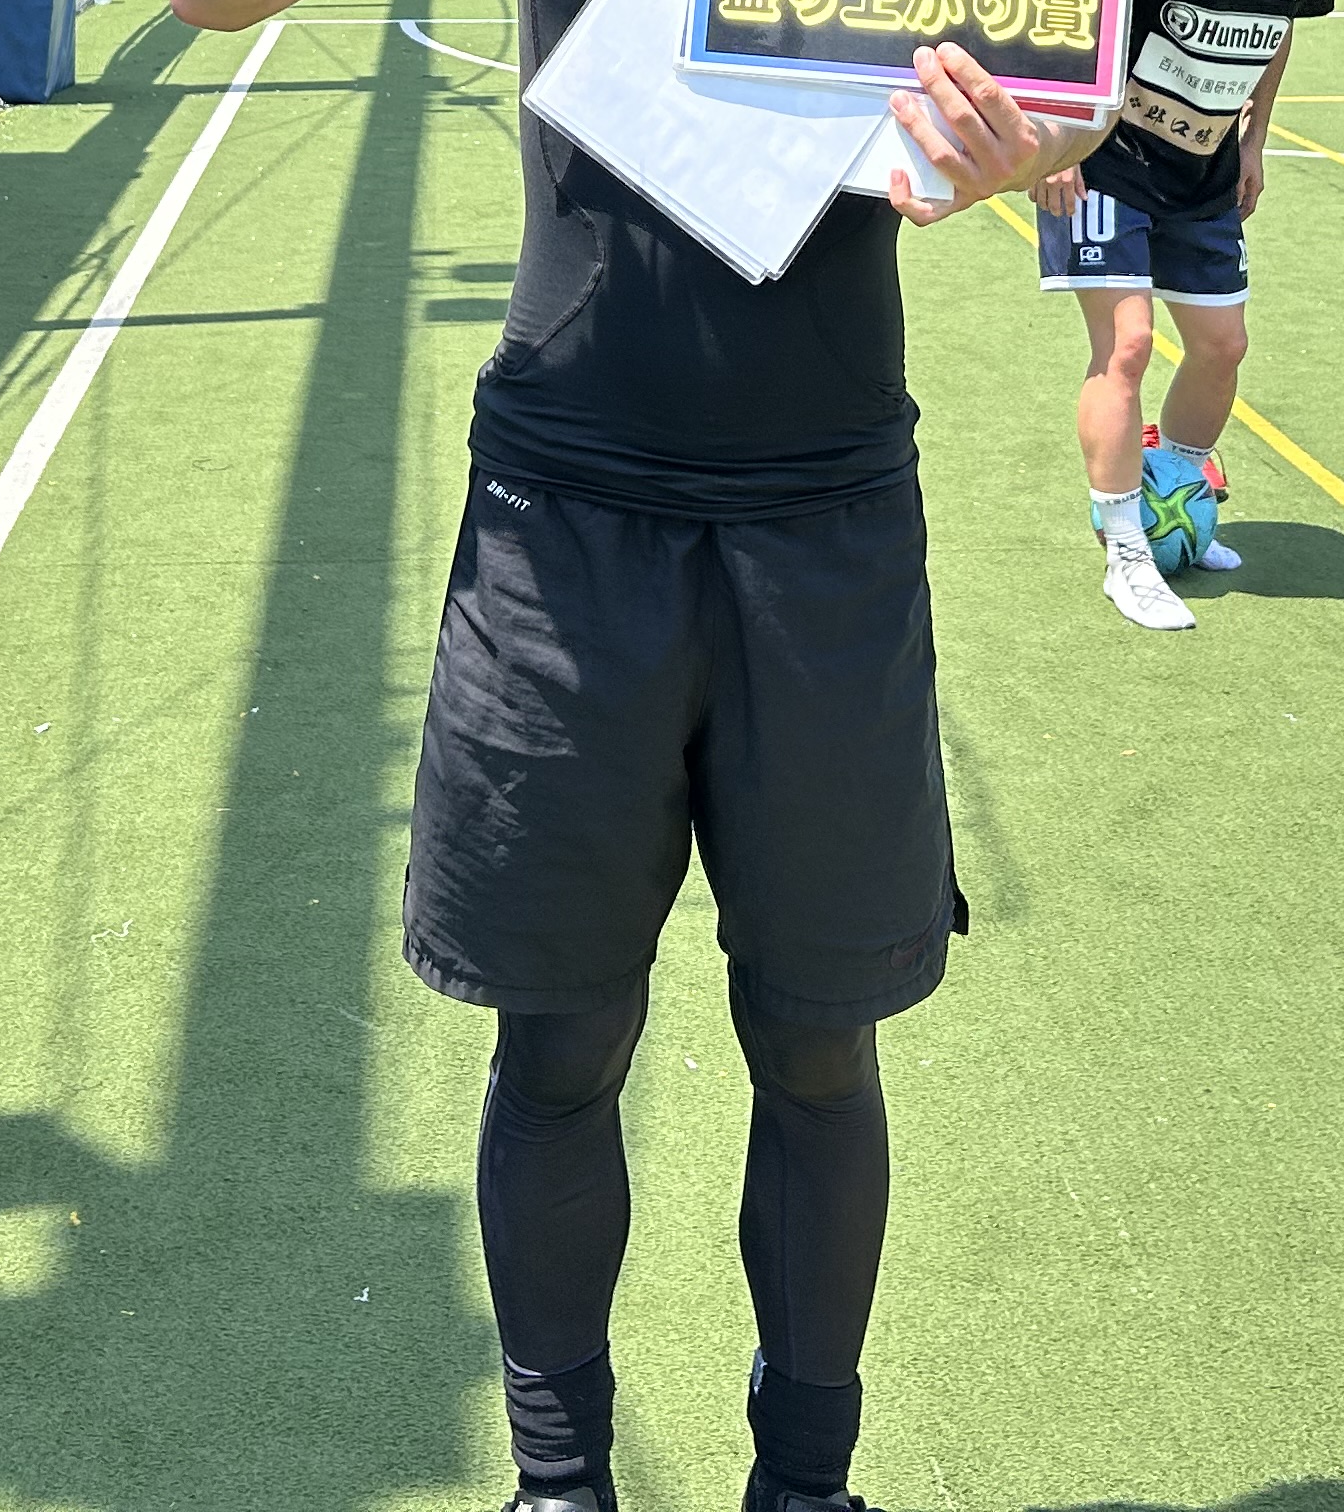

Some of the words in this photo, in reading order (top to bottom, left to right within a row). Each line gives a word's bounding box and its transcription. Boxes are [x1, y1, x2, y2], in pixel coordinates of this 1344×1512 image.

[1197, 18, 1283, 50] Humble
[1158, 55, 1256, 96] 百水庭園研究所
